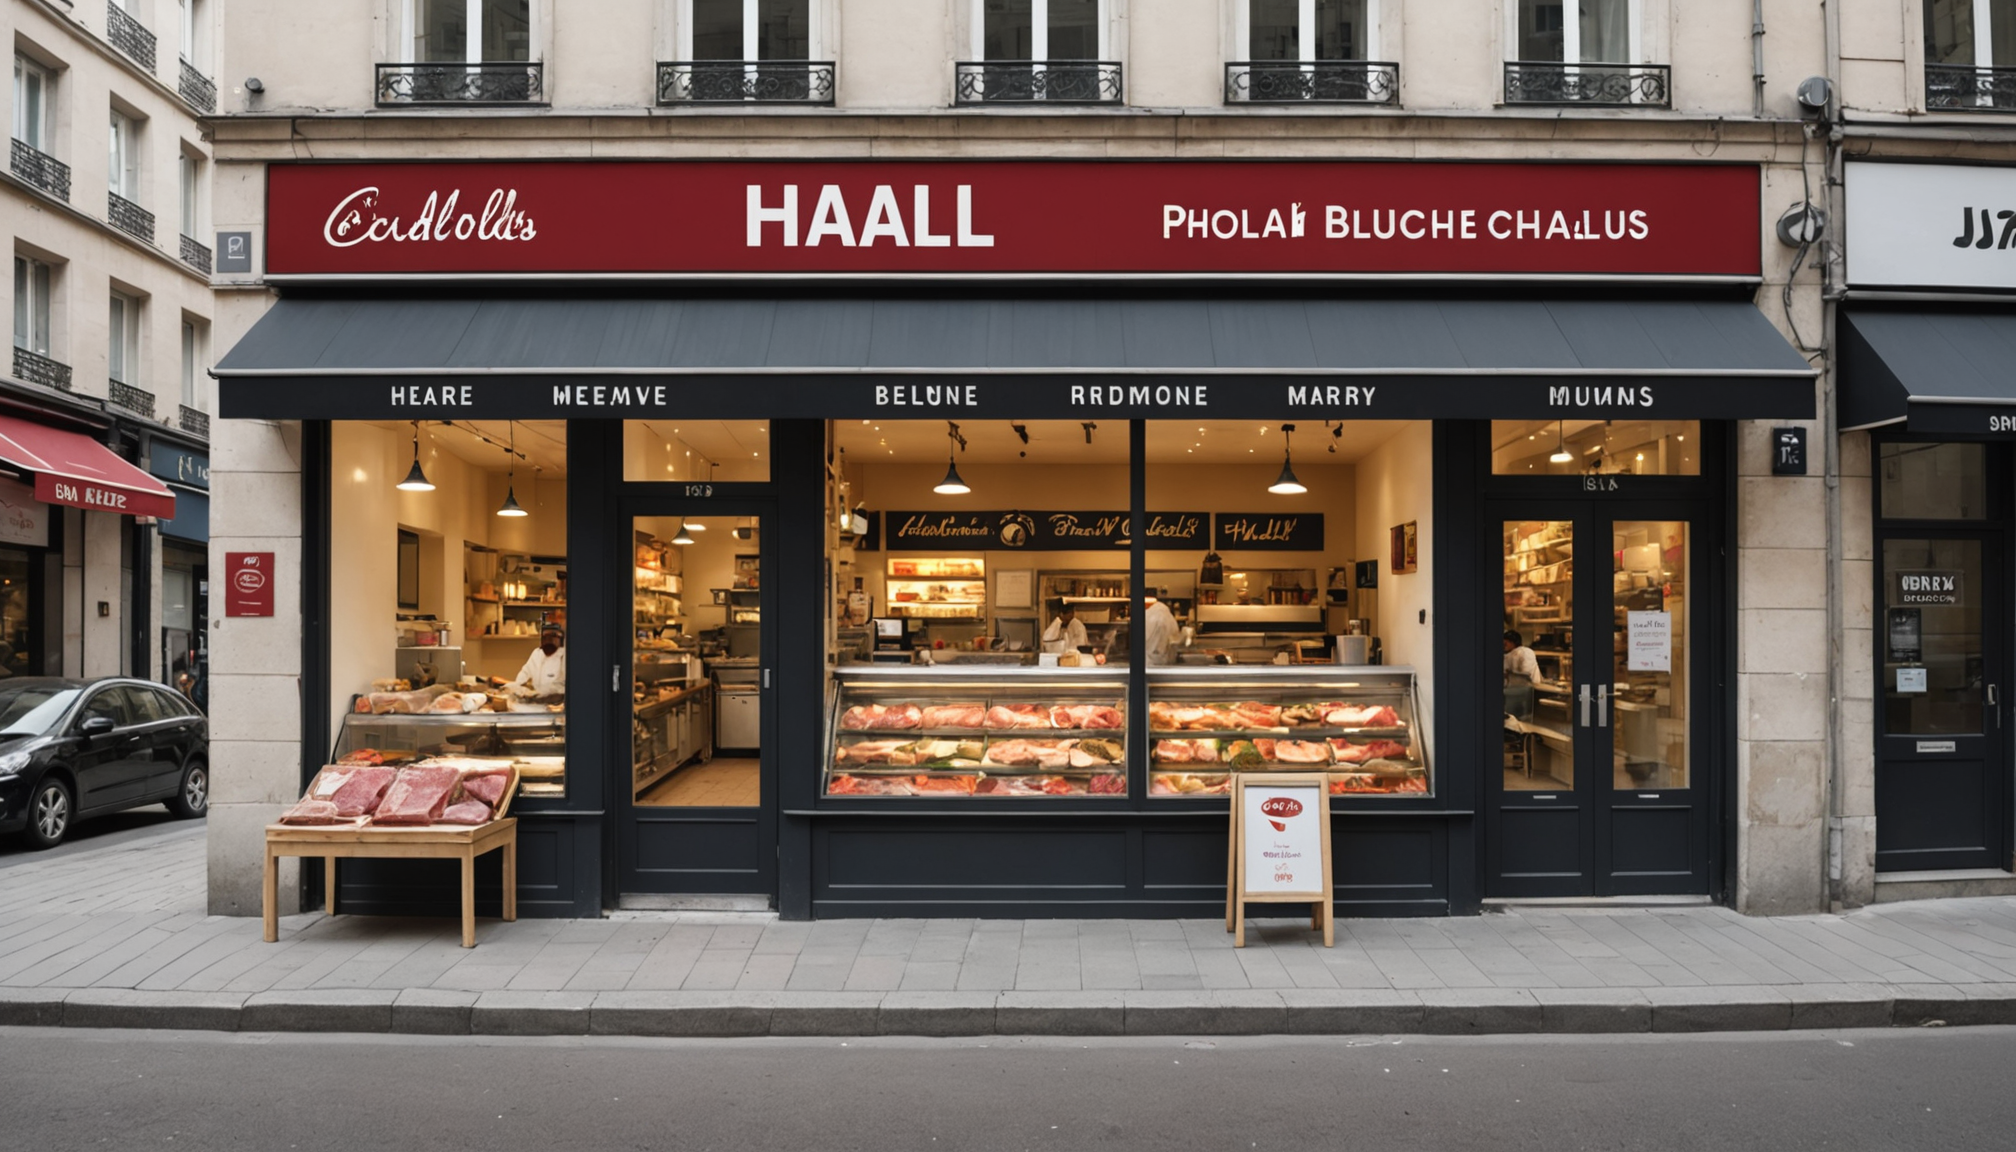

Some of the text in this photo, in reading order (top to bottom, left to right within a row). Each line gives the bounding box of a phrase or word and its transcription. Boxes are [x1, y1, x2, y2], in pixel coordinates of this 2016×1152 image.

[746, 184, 995, 247] HAALL
[1325, 205, 1478, 240] BLUCHE
[391, 385, 473, 406] HEARE
[1288, 385, 1377, 406] MARRY
